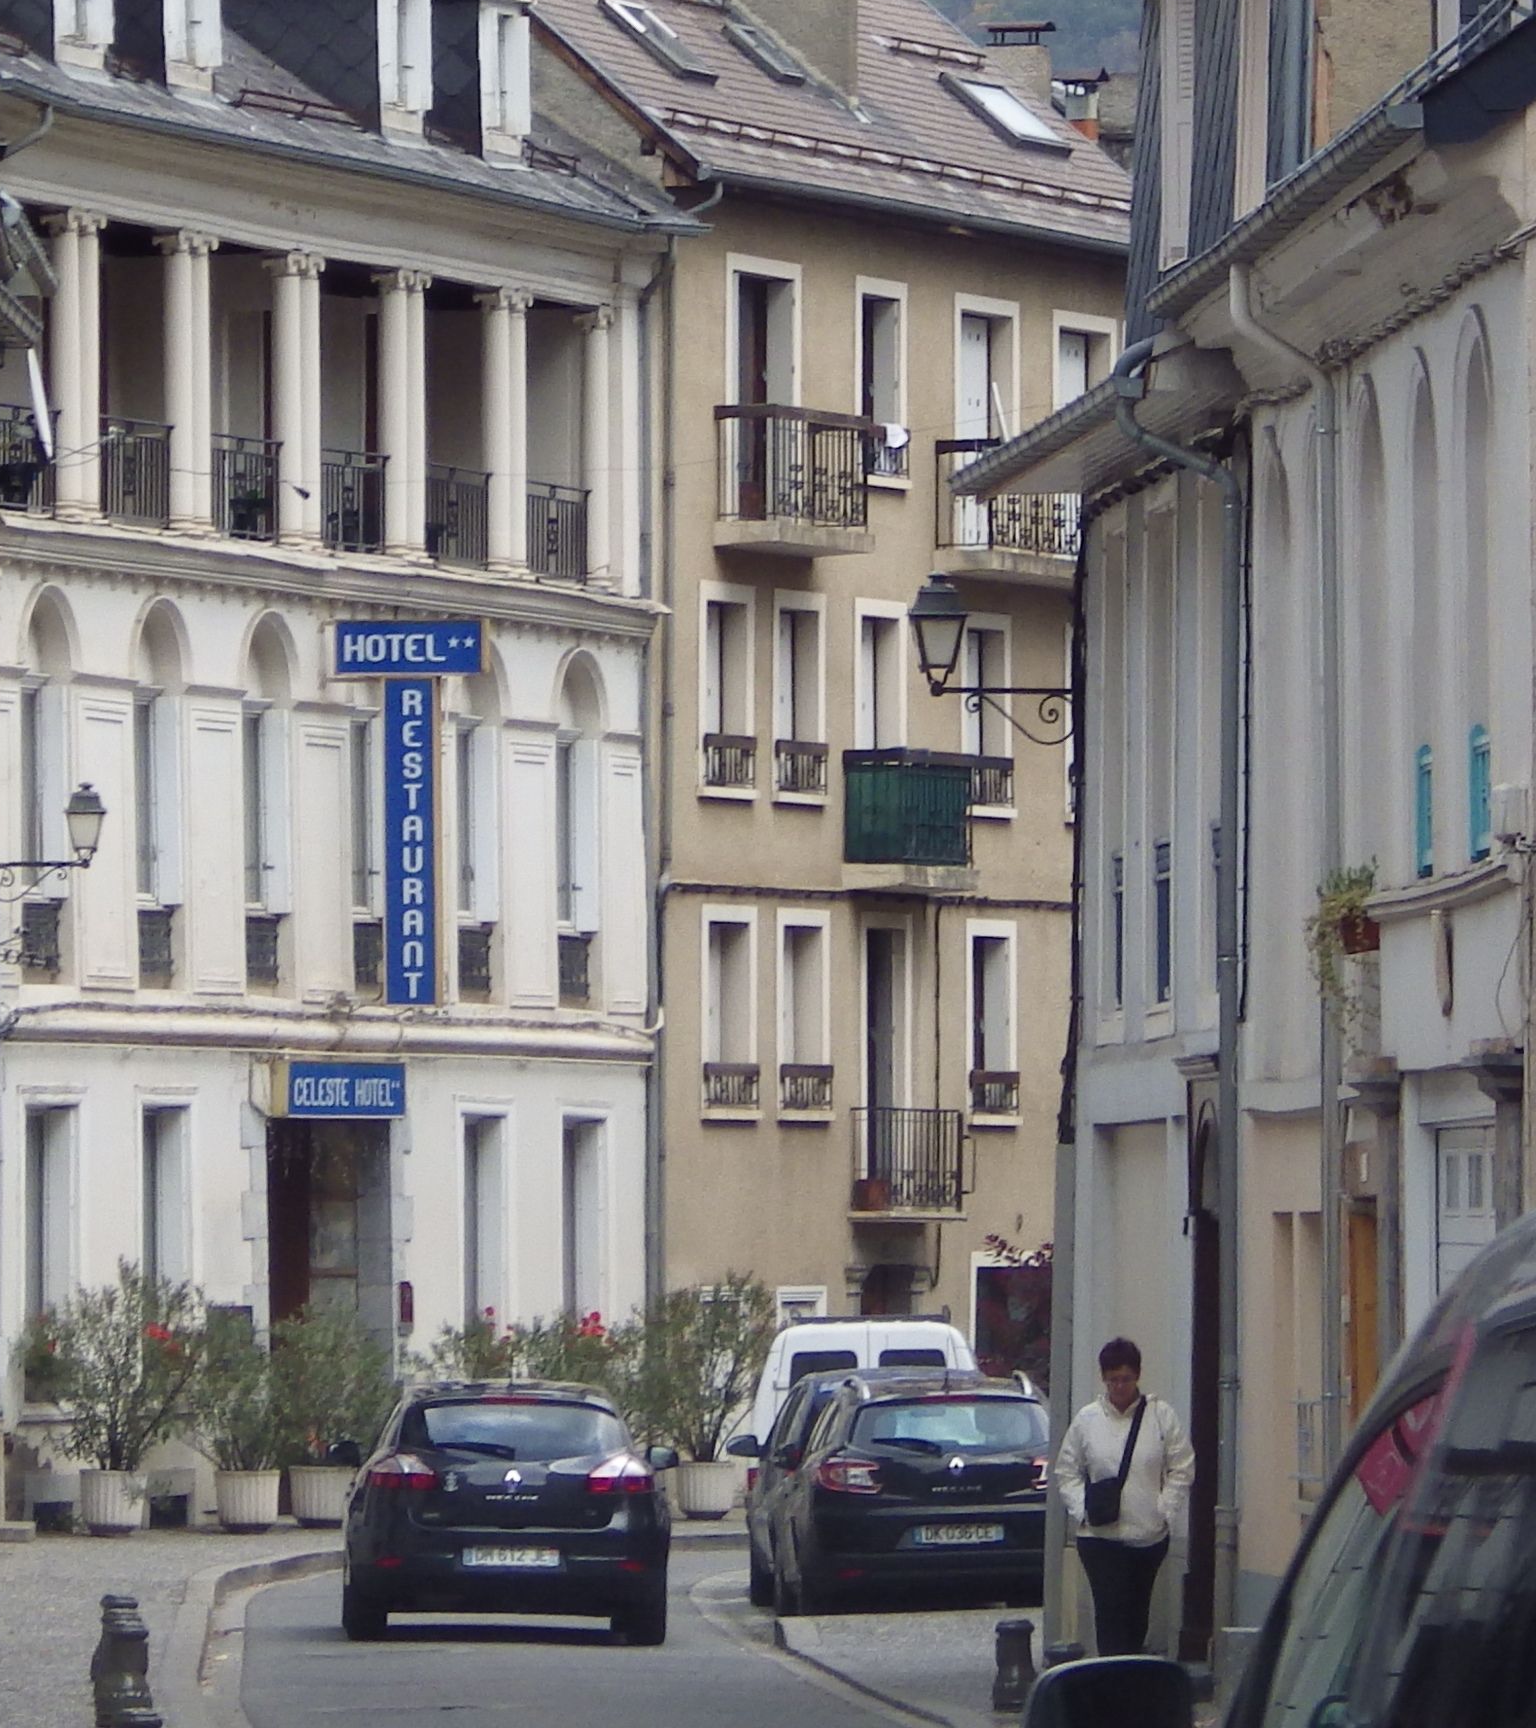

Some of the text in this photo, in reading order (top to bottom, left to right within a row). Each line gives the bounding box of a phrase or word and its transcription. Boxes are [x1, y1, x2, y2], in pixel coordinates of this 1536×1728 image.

[343, 634, 447, 663] HOTEL
[401, 689, 425, 1001] RESTAURANT
[294, 1077, 395, 1107] CELESTE HOTEL
